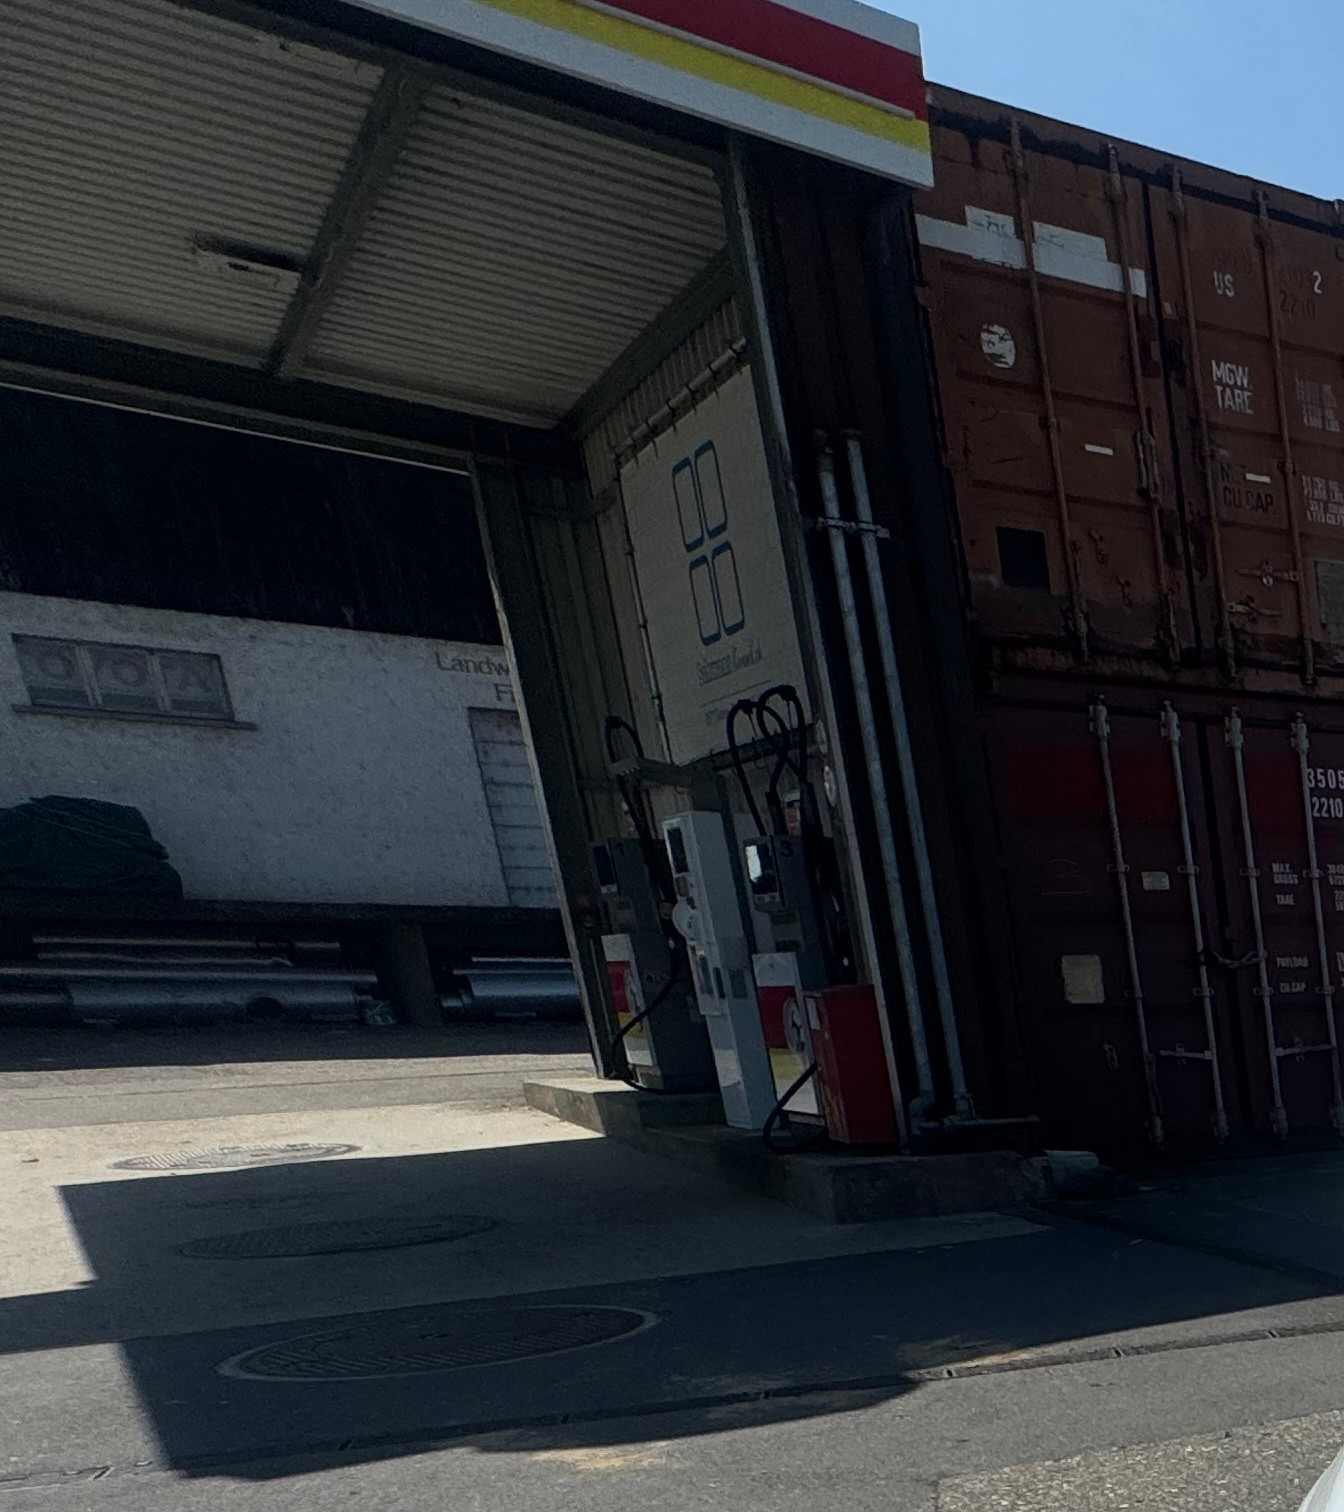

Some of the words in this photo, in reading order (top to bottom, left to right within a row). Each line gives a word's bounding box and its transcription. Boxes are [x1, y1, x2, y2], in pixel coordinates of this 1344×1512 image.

[1213, 270, 1235, 297] US
[1312, 270, 1322, 294] 2
[1312, 797, 1343, 818] 2210
[780, 839, 794, 858] 3
